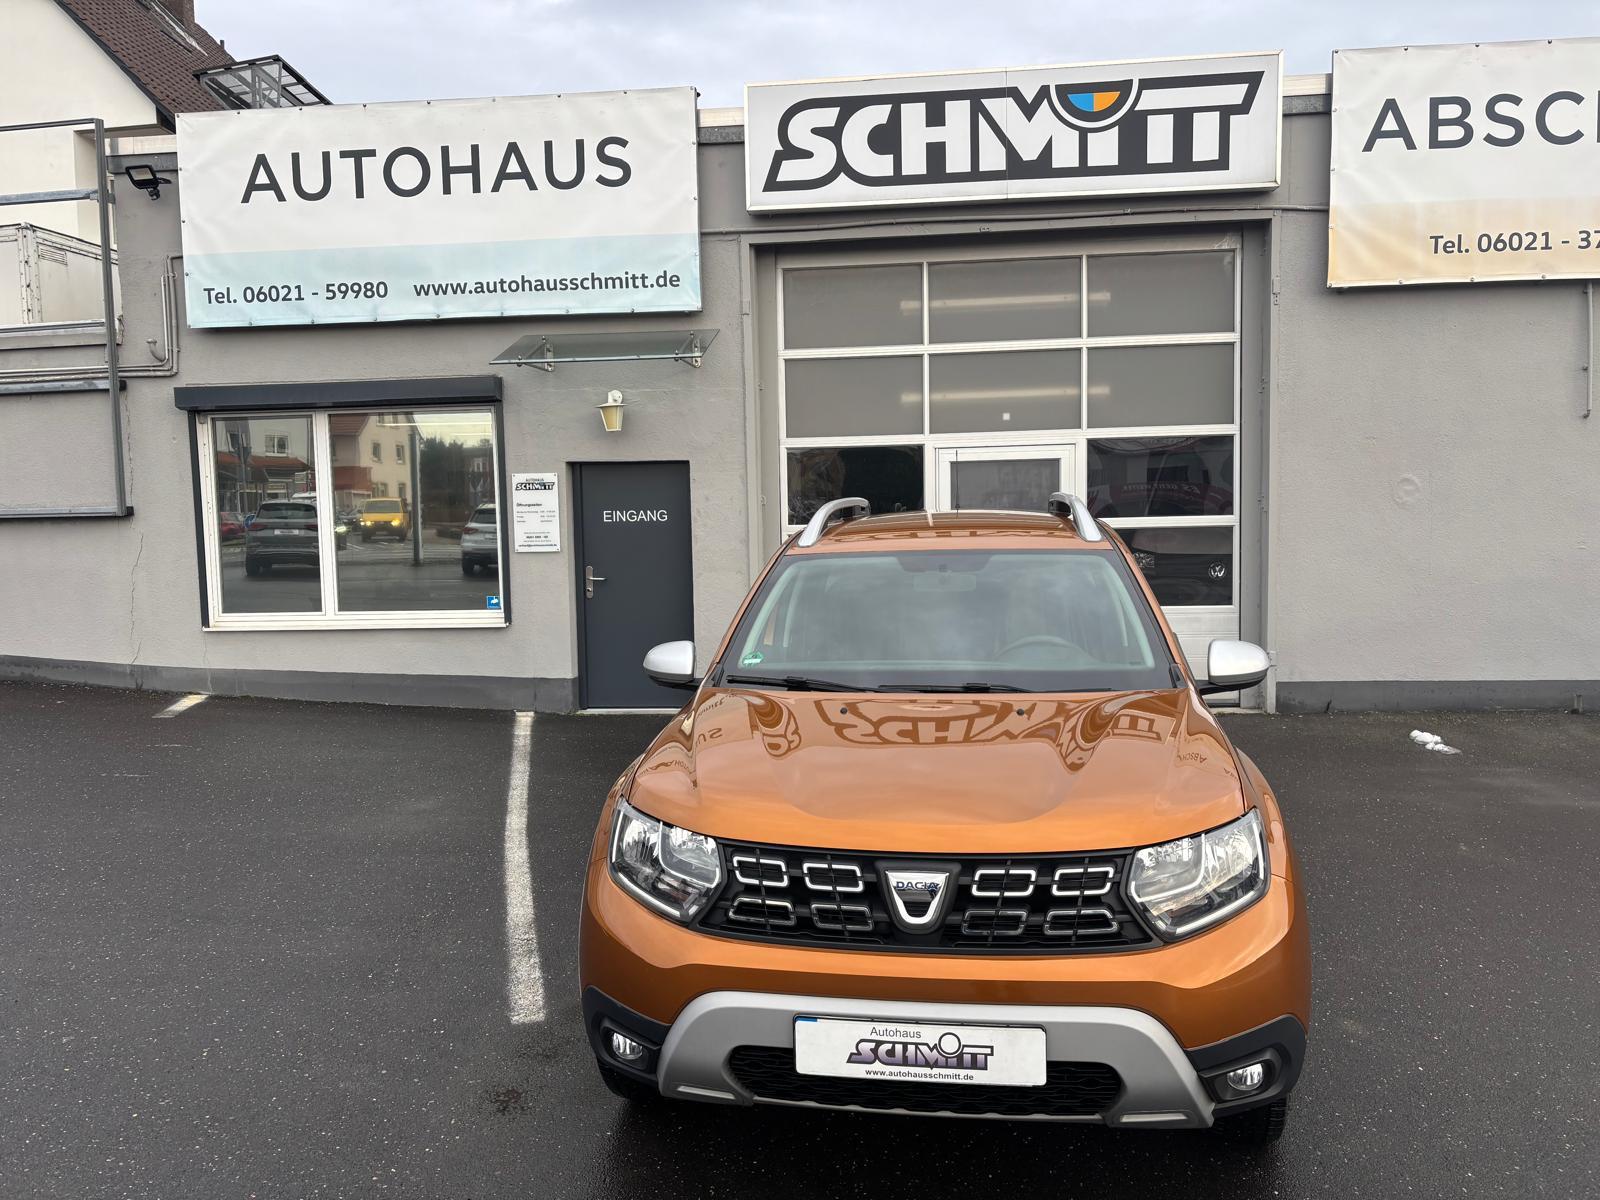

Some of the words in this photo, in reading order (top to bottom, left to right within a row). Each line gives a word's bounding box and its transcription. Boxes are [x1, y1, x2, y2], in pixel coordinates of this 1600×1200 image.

[762, 71, 1265, 193] SCHMITT
[1361, 90, 1600, 152] ABSC
[240, 135, 632, 204] AUTOHAUS
[1429, 234, 1470, 254] Tel.
[1477, 231, 1553, 252] 06021
[203, 286, 238, 305] Tel.
[242, 284, 305, 303] 06021
[325, 281, 389, 301] 59980
[413, 270, 681, 297] www.autohausschmitt.de
[515, 482, 555, 491] SCHMITT
[603, 510, 668, 523] EINGANG
[895, 881, 939, 891] DACIA
[870, 1026, 922, 1039] Autohaus
[846, 1032, 994, 1070] SCHMITT
[864, 1068, 974, 1081] www.autohausschmitt.de
